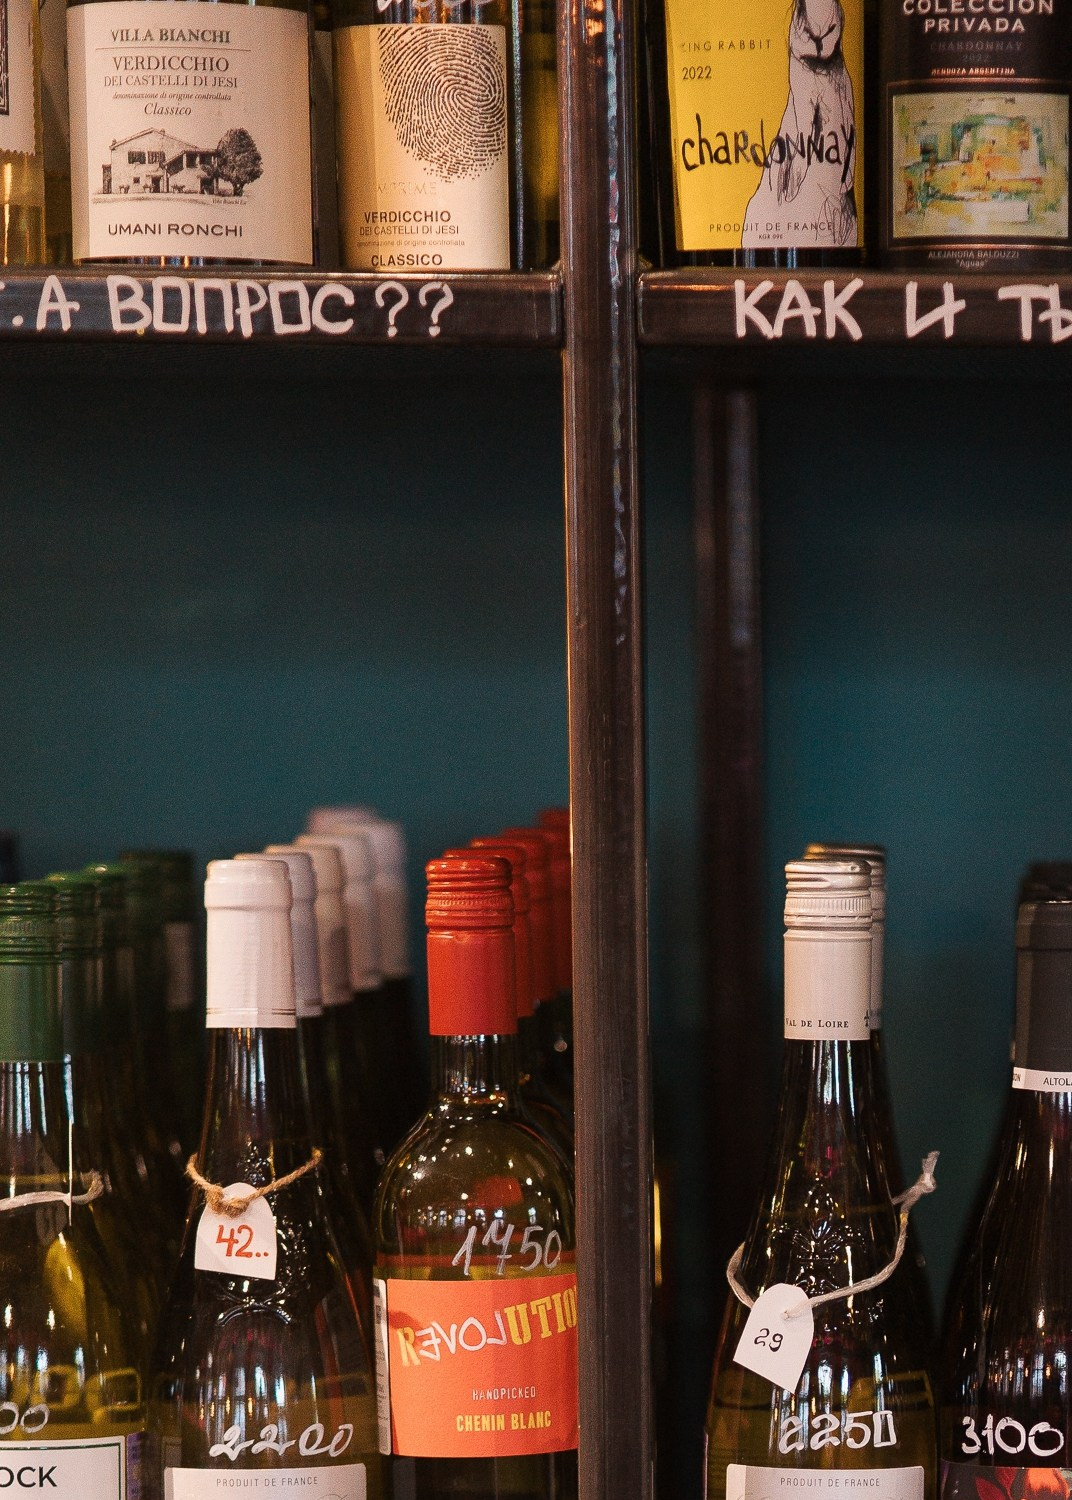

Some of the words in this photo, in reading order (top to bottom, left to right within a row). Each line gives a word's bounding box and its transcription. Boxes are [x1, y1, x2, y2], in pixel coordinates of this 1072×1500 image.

[924, 17, 1026, 33] PRIVADA
[111, 28, 155, 42] VILLA
[159, 28, 231, 43] BIANCHI
[718, 39, 772, 51] RABBIT
[112, 55, 230, 72] VERDICCHIO
[682, 65, 713, 80] 2022
[104, 75, 122, 87] DEI
[125, 74, 189, 87] CASTELLI
[193, 75, 208, 87] DI
[211, 77, 238, 88] JESI
[144, 102, 192, 116] Classico
[364, 210, 452, 223] VERDICCHIO
[107, 223, 163, 236] UMANI
[167, 223, 243, 238] RONCHI
[360, 226, 373, 236] DEI
[374, 225, 419, 235] CASTELLI
[421, 225, 433, 235] DI
[435, 225, 459, 235] JESI
[709, 223, 760, 233] PRODUIT
[765, 223, 783, 232] DE
[787, 221, 834, 232] FRANCE
[371, 254, 443, 267] CLASSICO
[108, 275, 355, 338] ВОПРОС
[734, 278, 864, 342] КАК
[905, 280, 966, 340] И
[753, 1327, 784, 1352] 29
[472, 1386, 537, 1400] HANDPICKED
[456, 1414, 505, 1433] CHENIN
[510, 1411, 552, 1430] BLANC
[777, 1409, 898, 1455] 2250
[961, 1413, 1065, 1456] 3100
[209, 1422, 354, 1460] 2200
[216, 1477, 260, 1488] PRODUIT
[264, 1477, 278, 1487] DE
[281, 1475, 319, 1487] FRANCE
[780, 1477, 822, 1488] PRODUIT
[825, 1477, 837, 1487] DE
[840, 1475, 881, 1488] FRANCE
